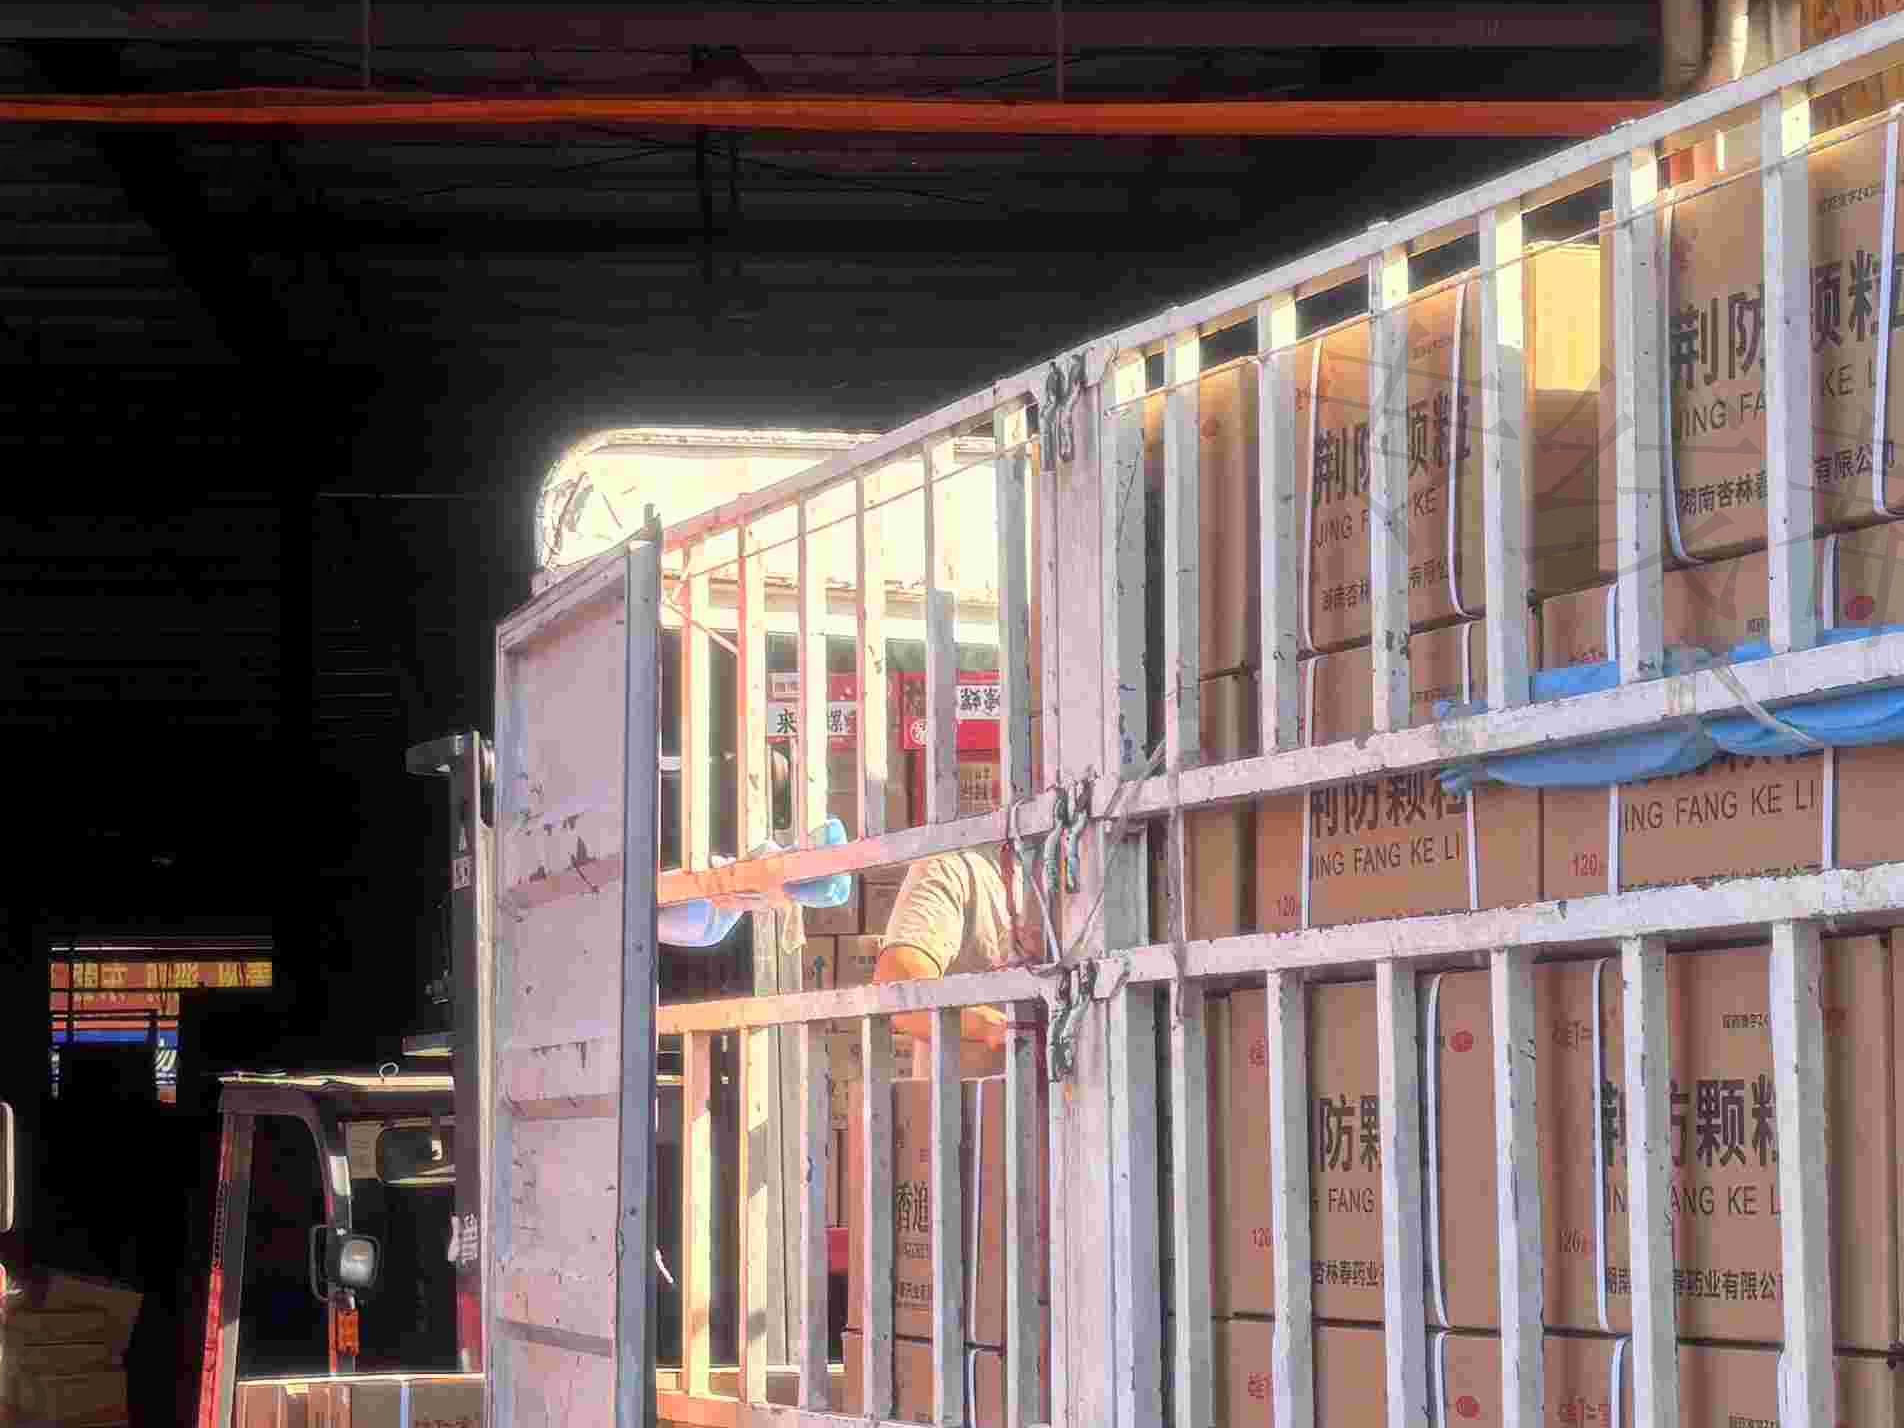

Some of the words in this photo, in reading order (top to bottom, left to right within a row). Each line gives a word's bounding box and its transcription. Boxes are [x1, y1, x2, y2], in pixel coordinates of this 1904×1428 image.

[1675, 790, 1739, 827] FANG
[1750, 783, 1785, 817] KE
[1795, 779, 1815, 811] LI
[1353, 843, 1401, 875] FANG
[1410, 836, 1434, 866] KE
[1443, 832, 1462, 861] LI
[1328, 1187, 1375, 1213] FANG
[1727, 1185, 1758, 1216] KE
